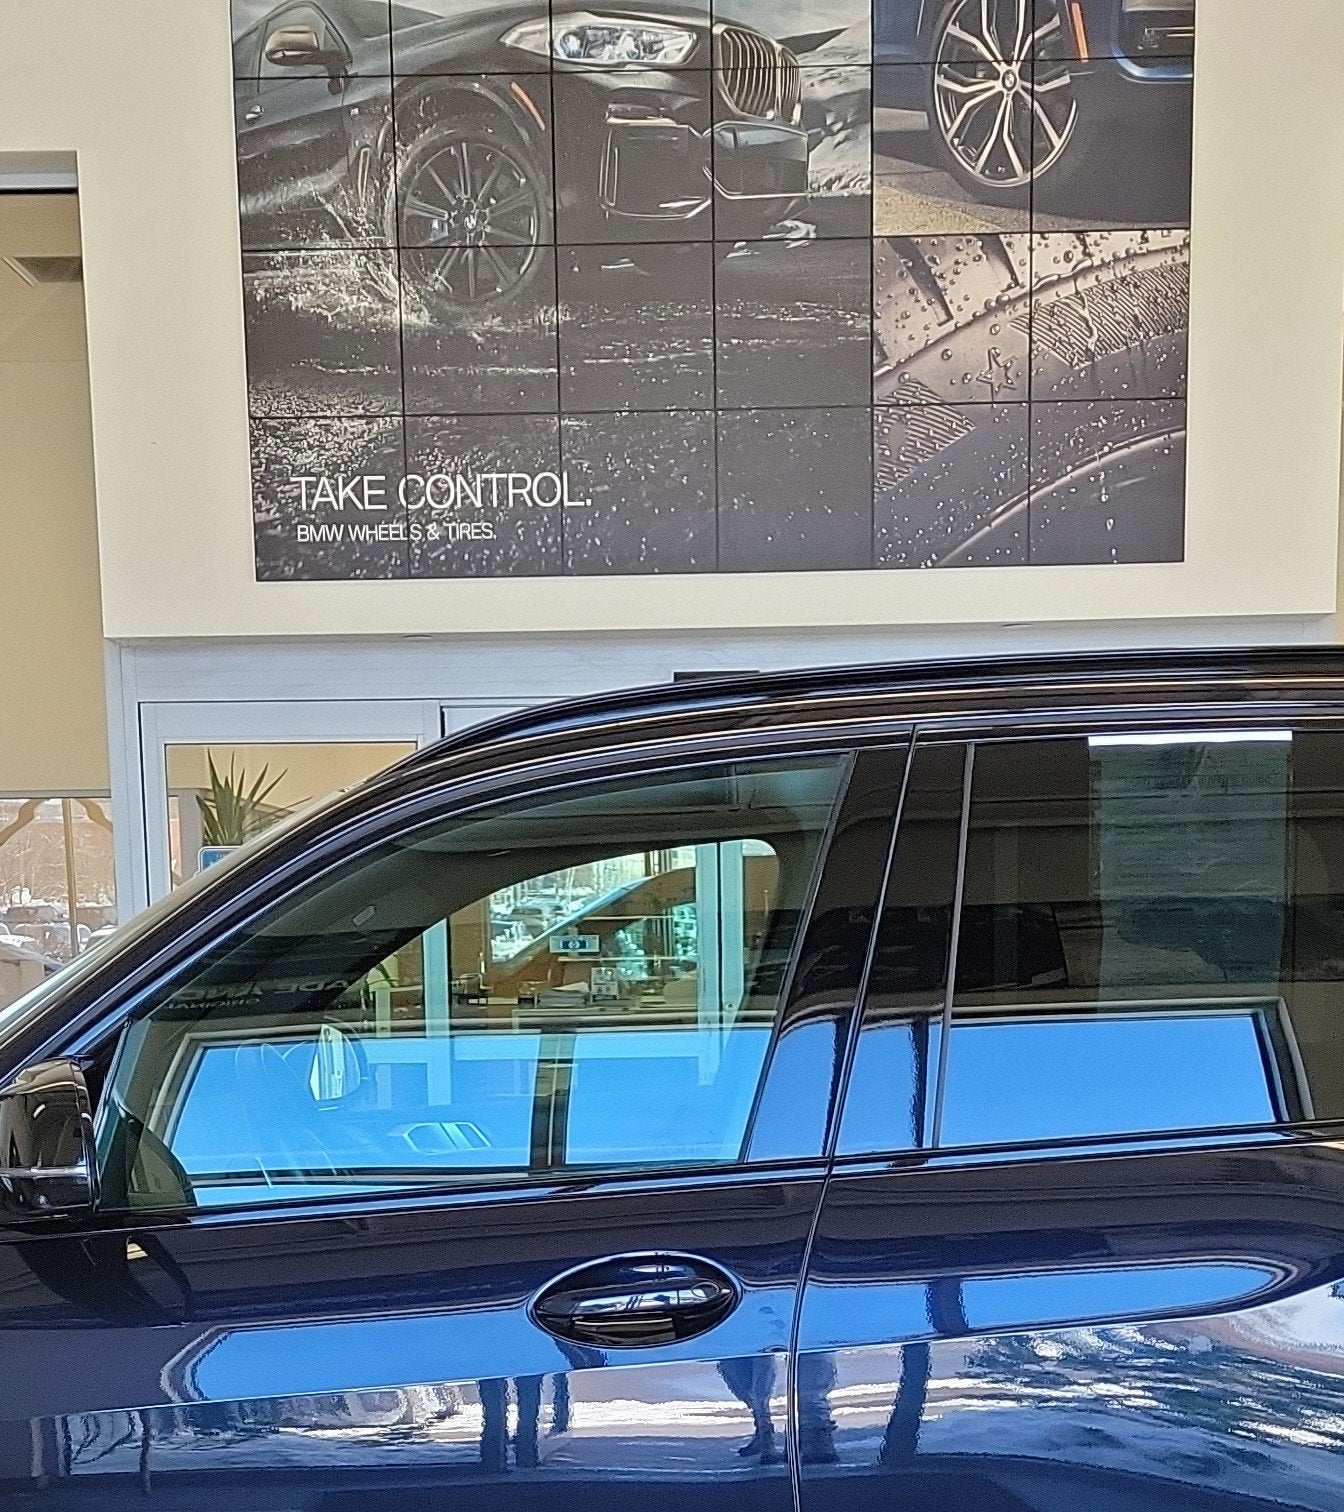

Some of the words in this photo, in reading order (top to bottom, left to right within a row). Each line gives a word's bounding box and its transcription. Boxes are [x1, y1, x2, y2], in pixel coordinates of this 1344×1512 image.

[289, 475, 388, 511] TAKE
[398, 470, 592, 510] CONTROL.
[296, 523, 345, 543] BMW
[348, 522, 423, 542] WHEELS
[427, 523, 441, 541] &
[445, 521, 498, 541] TIRES.
